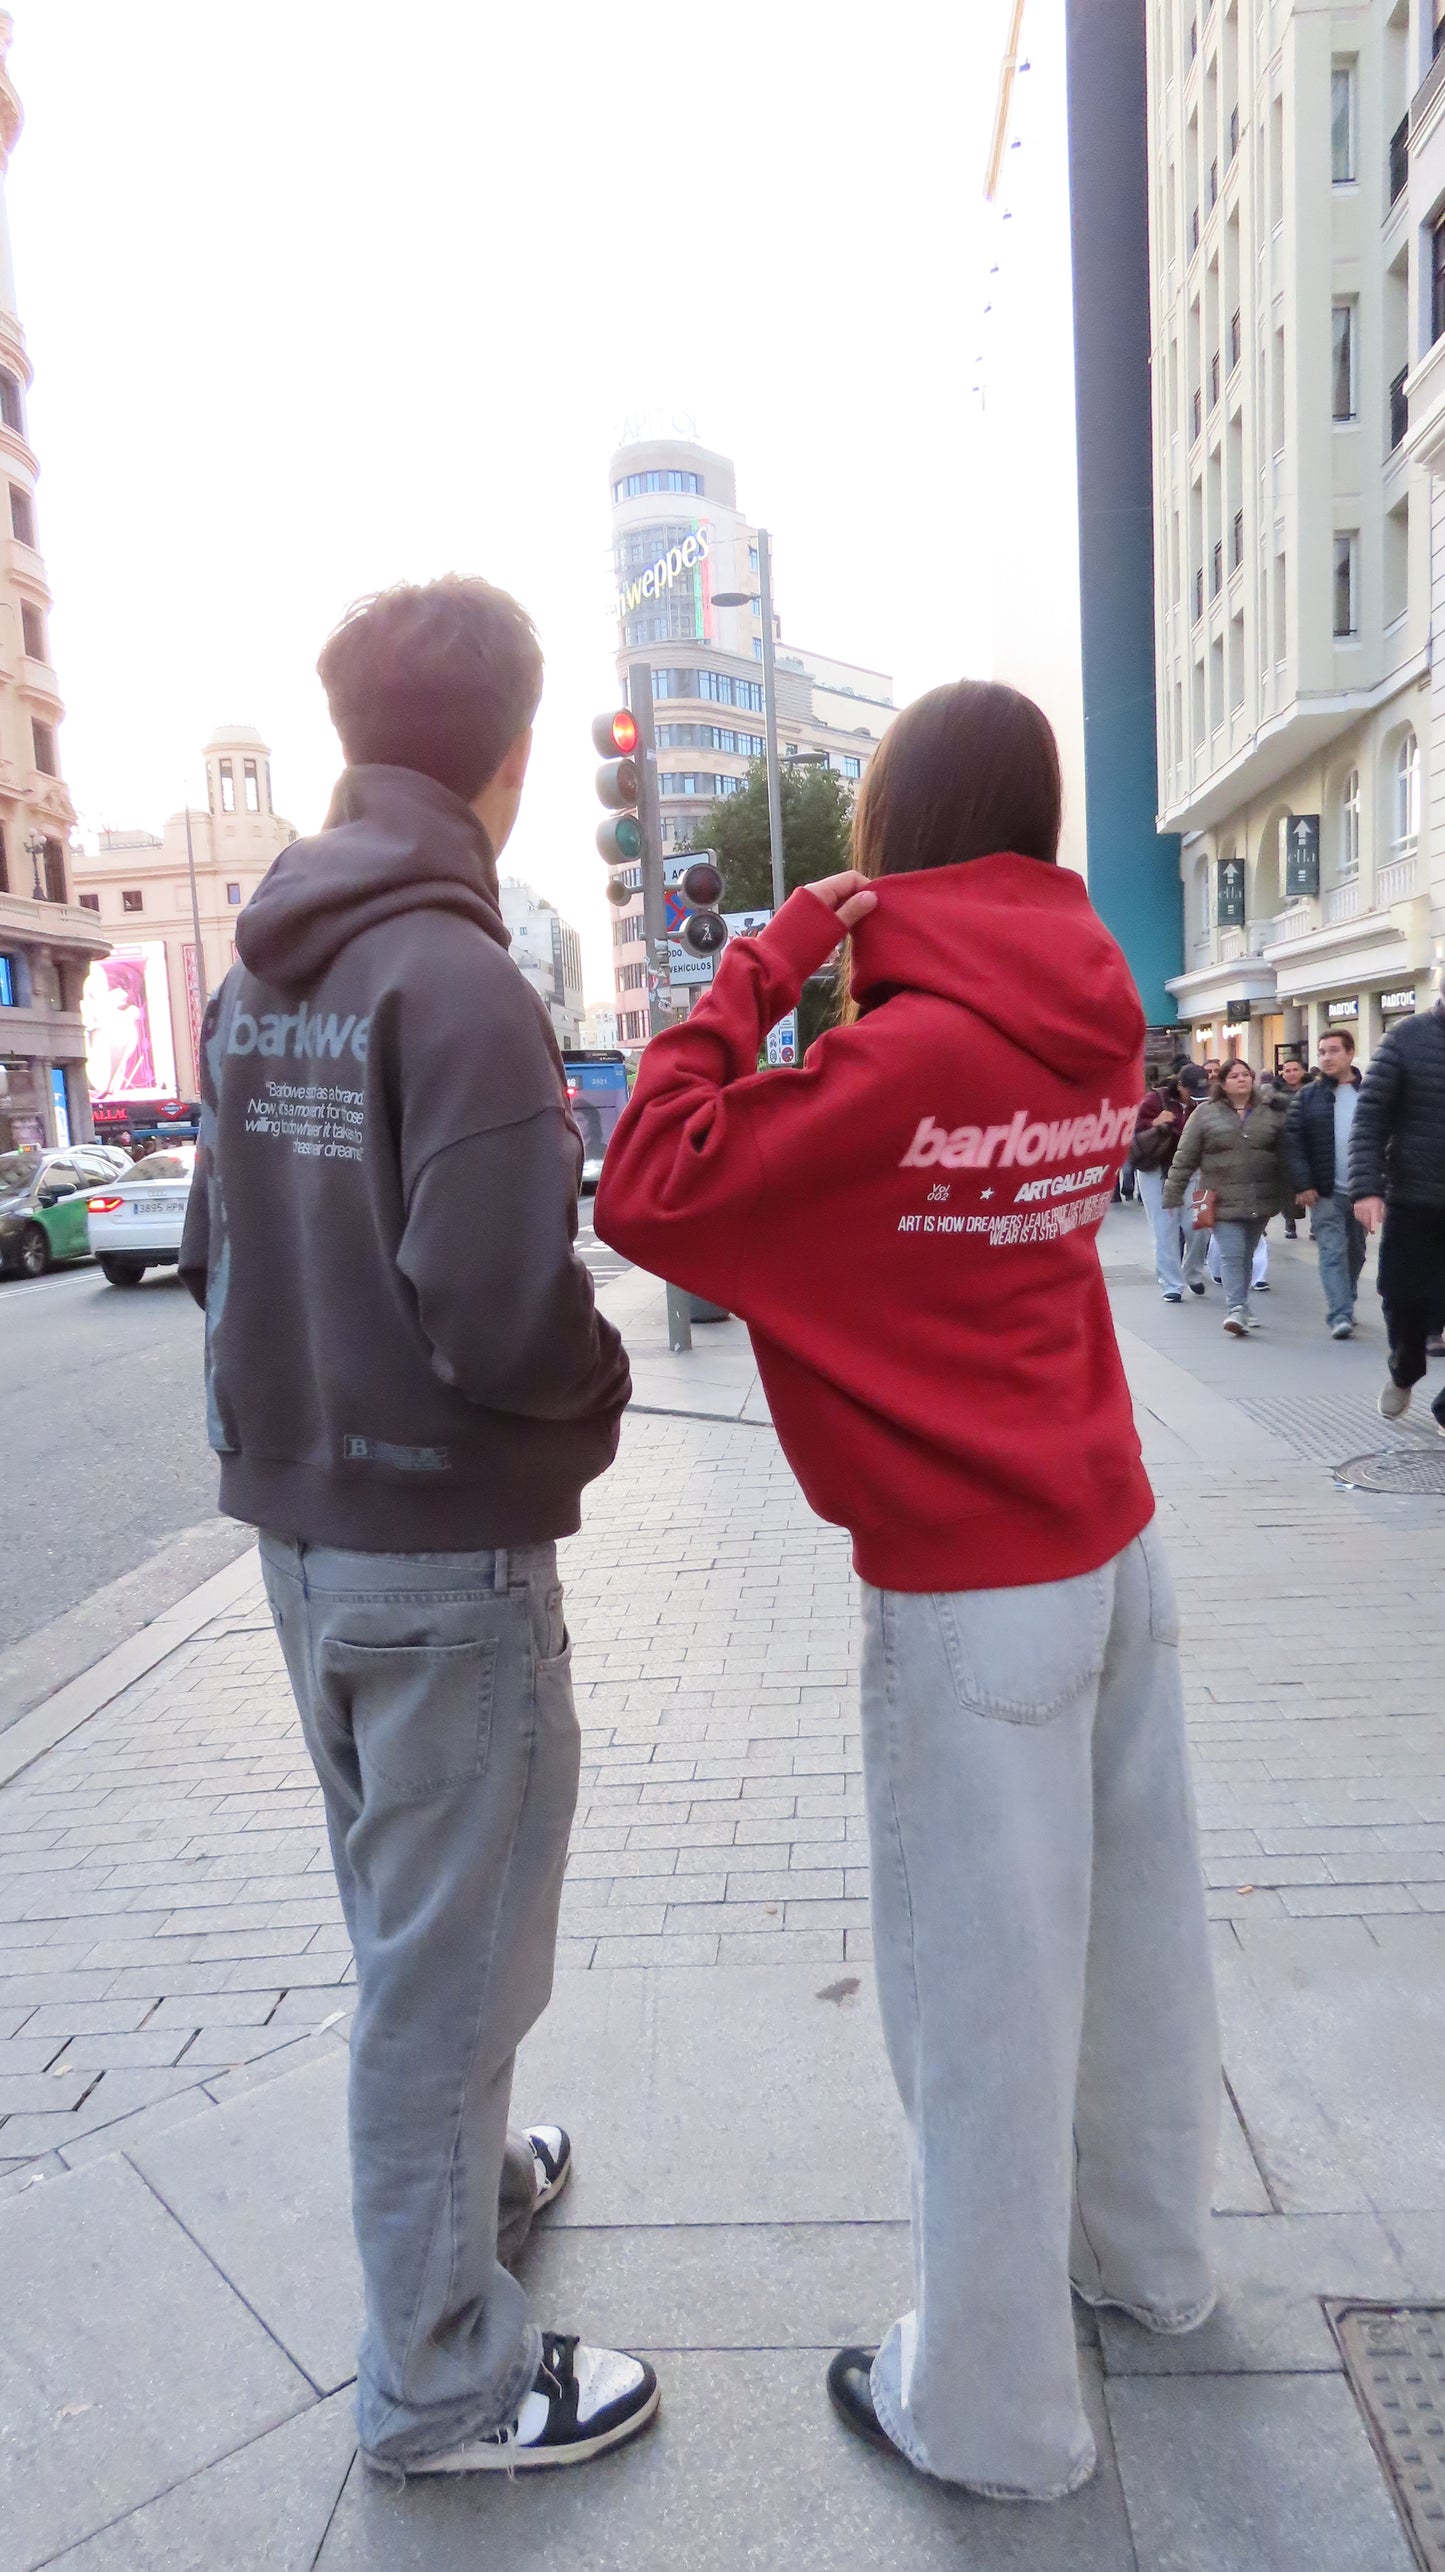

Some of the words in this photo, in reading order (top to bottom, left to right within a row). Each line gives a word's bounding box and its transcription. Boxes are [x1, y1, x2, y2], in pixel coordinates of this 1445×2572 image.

[613, 408, 701, 441] APITOL
[933, 1184, 950, 1193] Vol
[1014, 1178, 1053, 1203] ART
[1050, 1164, 1110, 1196] GALLERY
[927, 1192, 949, 1201] 002
[897, 1215, 922, 1231] ART
[923, 1215, 936, 1232] IS
[936, 1216, 965, 1232] HOW
[965, 1213, 1024, 1233] DREAMERS
[1022, 1209, 1051, 1229] LEAVE
[989, 1225, 1021, 1246] WEAR
[1018, 1224, 1030, 1244] IS
[1029, 1223, 1039, 1242] A
[1038, 1220, 1058, 1241] STEP
[348, 1438, 369, 1457] B
